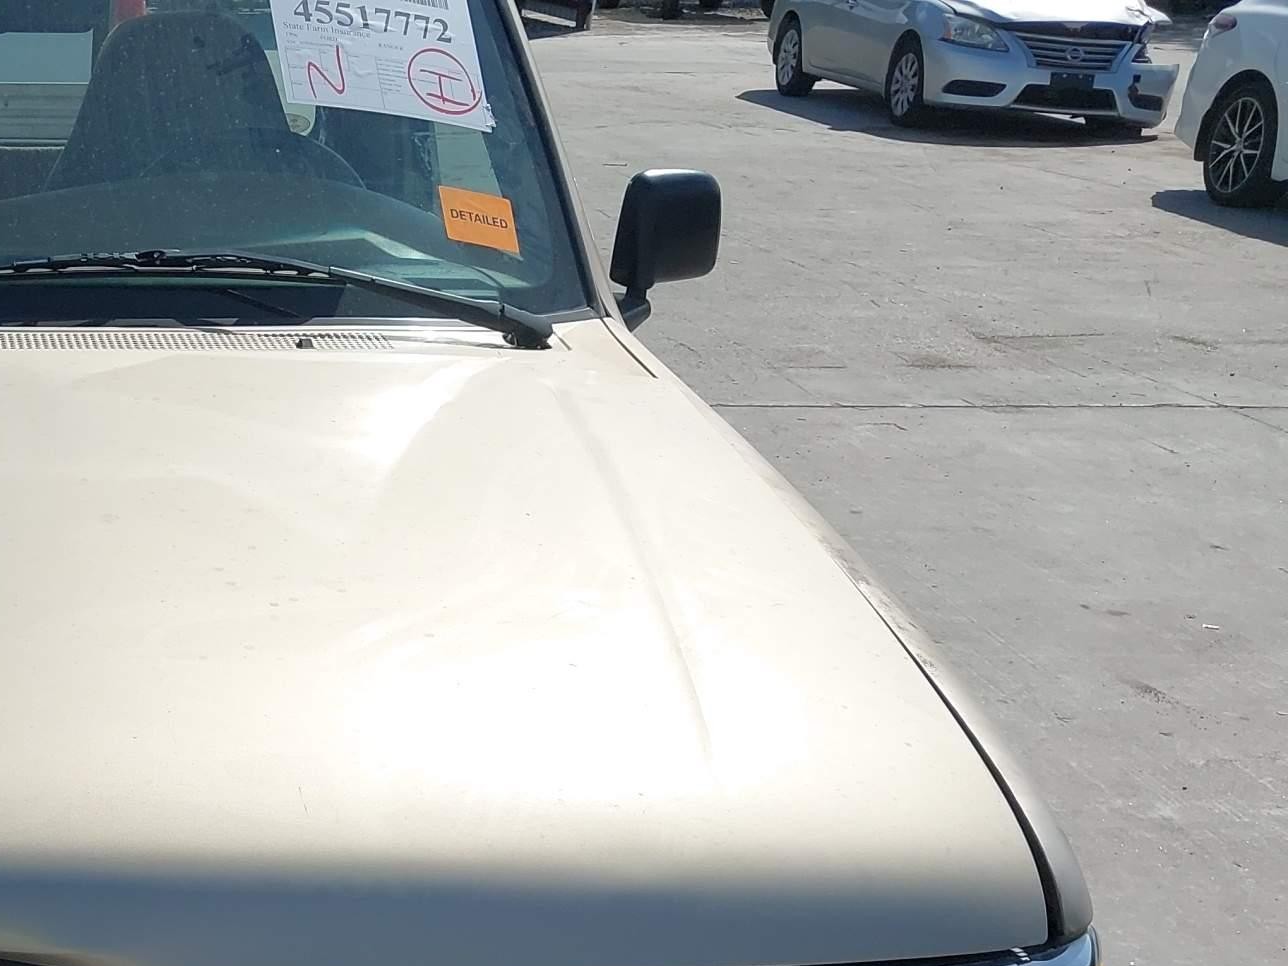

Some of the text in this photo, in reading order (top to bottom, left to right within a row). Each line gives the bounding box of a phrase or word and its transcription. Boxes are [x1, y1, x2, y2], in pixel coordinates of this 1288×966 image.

[283, 21, 371, 39] State Farm Insurance
[294, 0, 451, 43] 45517772
[450, 208, 508, 229] DETAILED
